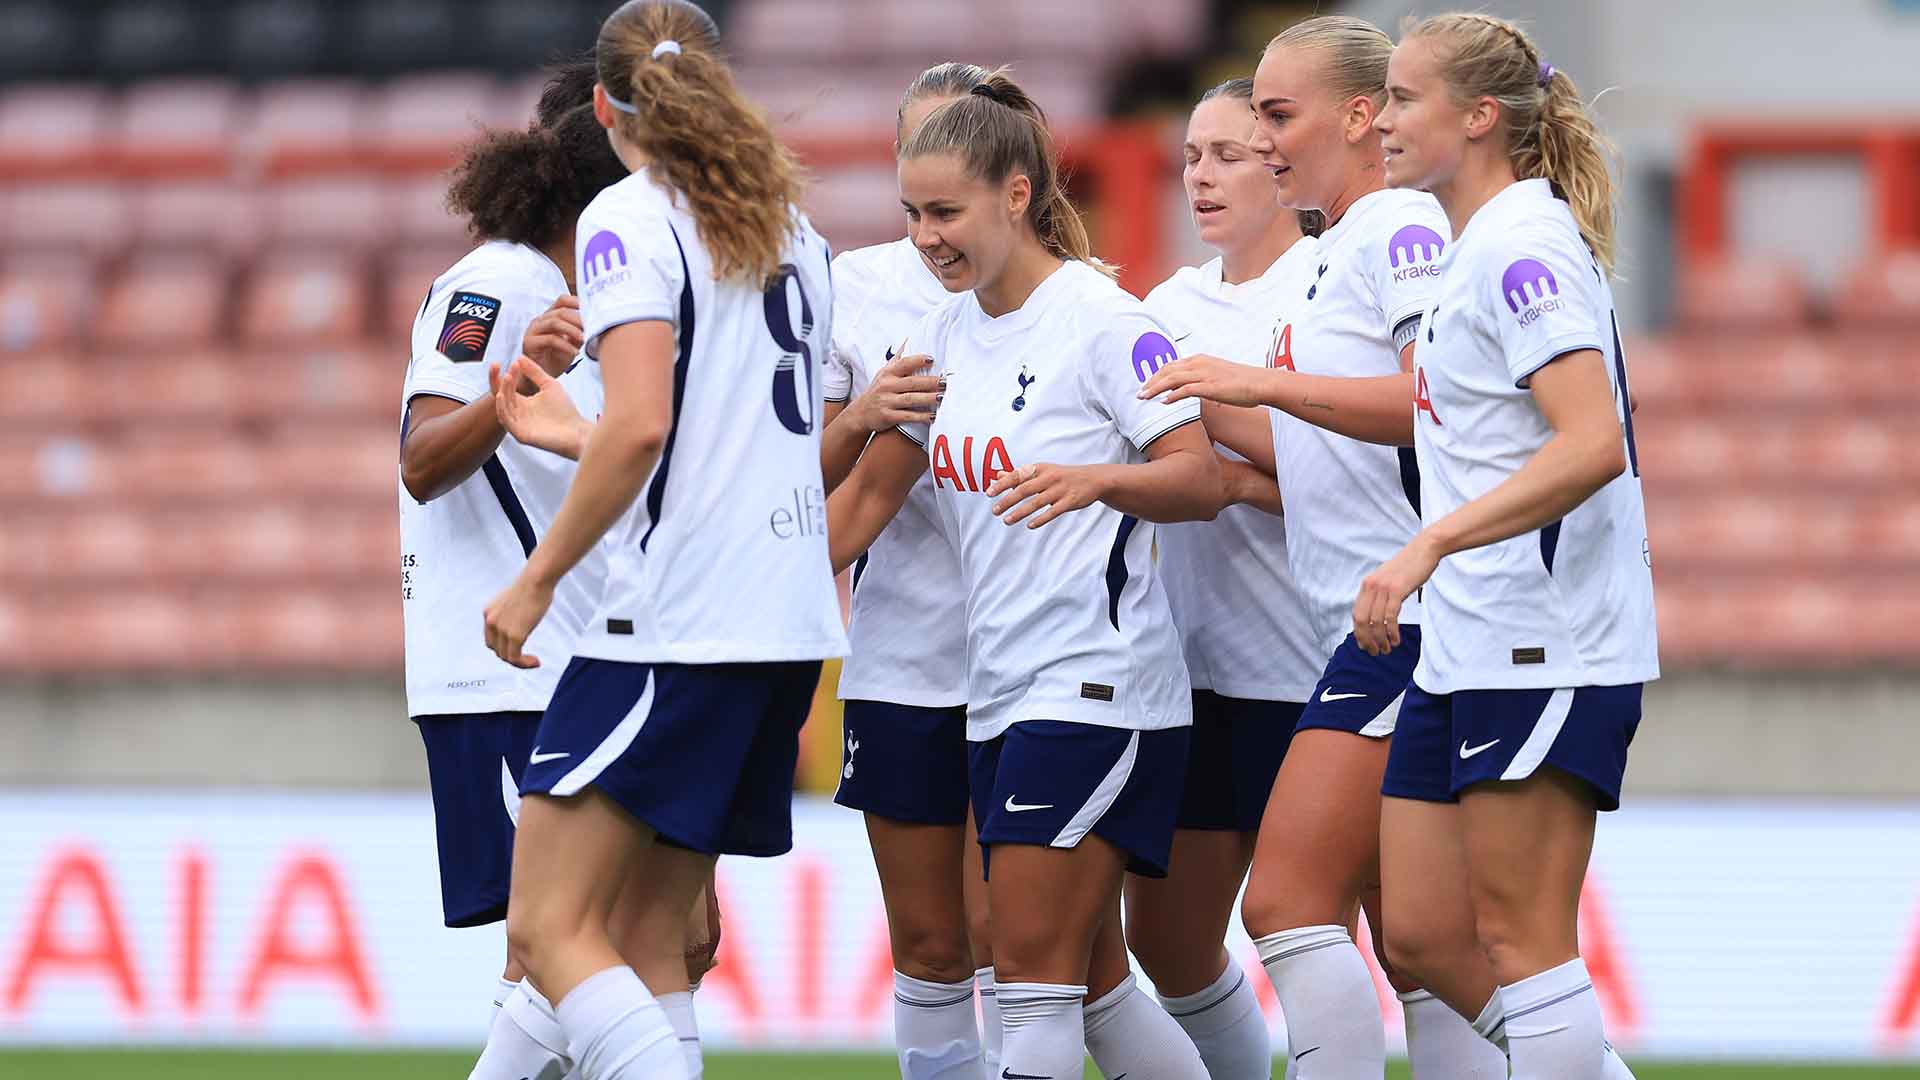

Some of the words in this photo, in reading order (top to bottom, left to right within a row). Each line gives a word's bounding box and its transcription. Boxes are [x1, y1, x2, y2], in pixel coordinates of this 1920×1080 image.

[1393, 264, 1442, 284] krake
[450, 301, 494, 321] WSL
[1517, 298, 1566, 329] kraken
[763, 263, 814, 436] 8
[932, 433, 1016, 493] AIA
[3, 853, 382, 1015] AIA
